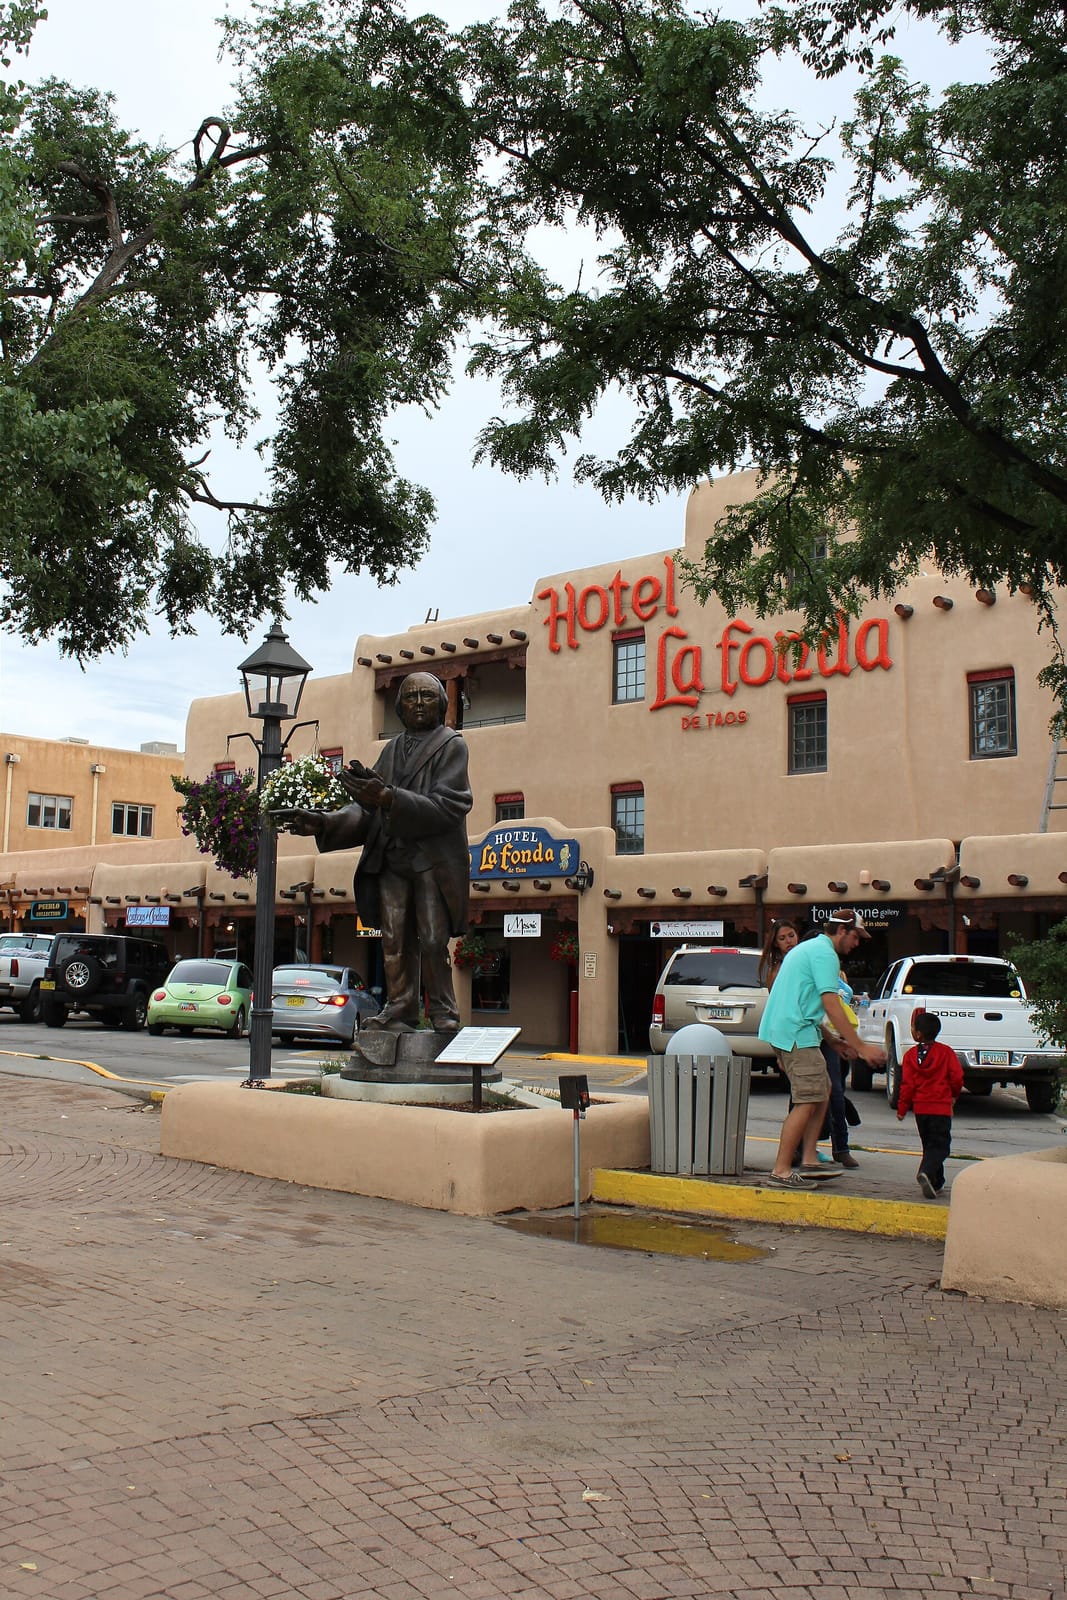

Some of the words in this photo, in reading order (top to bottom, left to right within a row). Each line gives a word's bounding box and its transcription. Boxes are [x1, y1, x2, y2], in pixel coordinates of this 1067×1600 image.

[537, 556, 679, 654] Hotel
[649, 626, 705, 711] La
[681, 716, 700, 730] DE
[706, 710, 747, 729] TAOS
[495, 831, 538, 845] HOTEL
[480, 844, 497, 871] La
[880, 908, 900, 919] gallery
